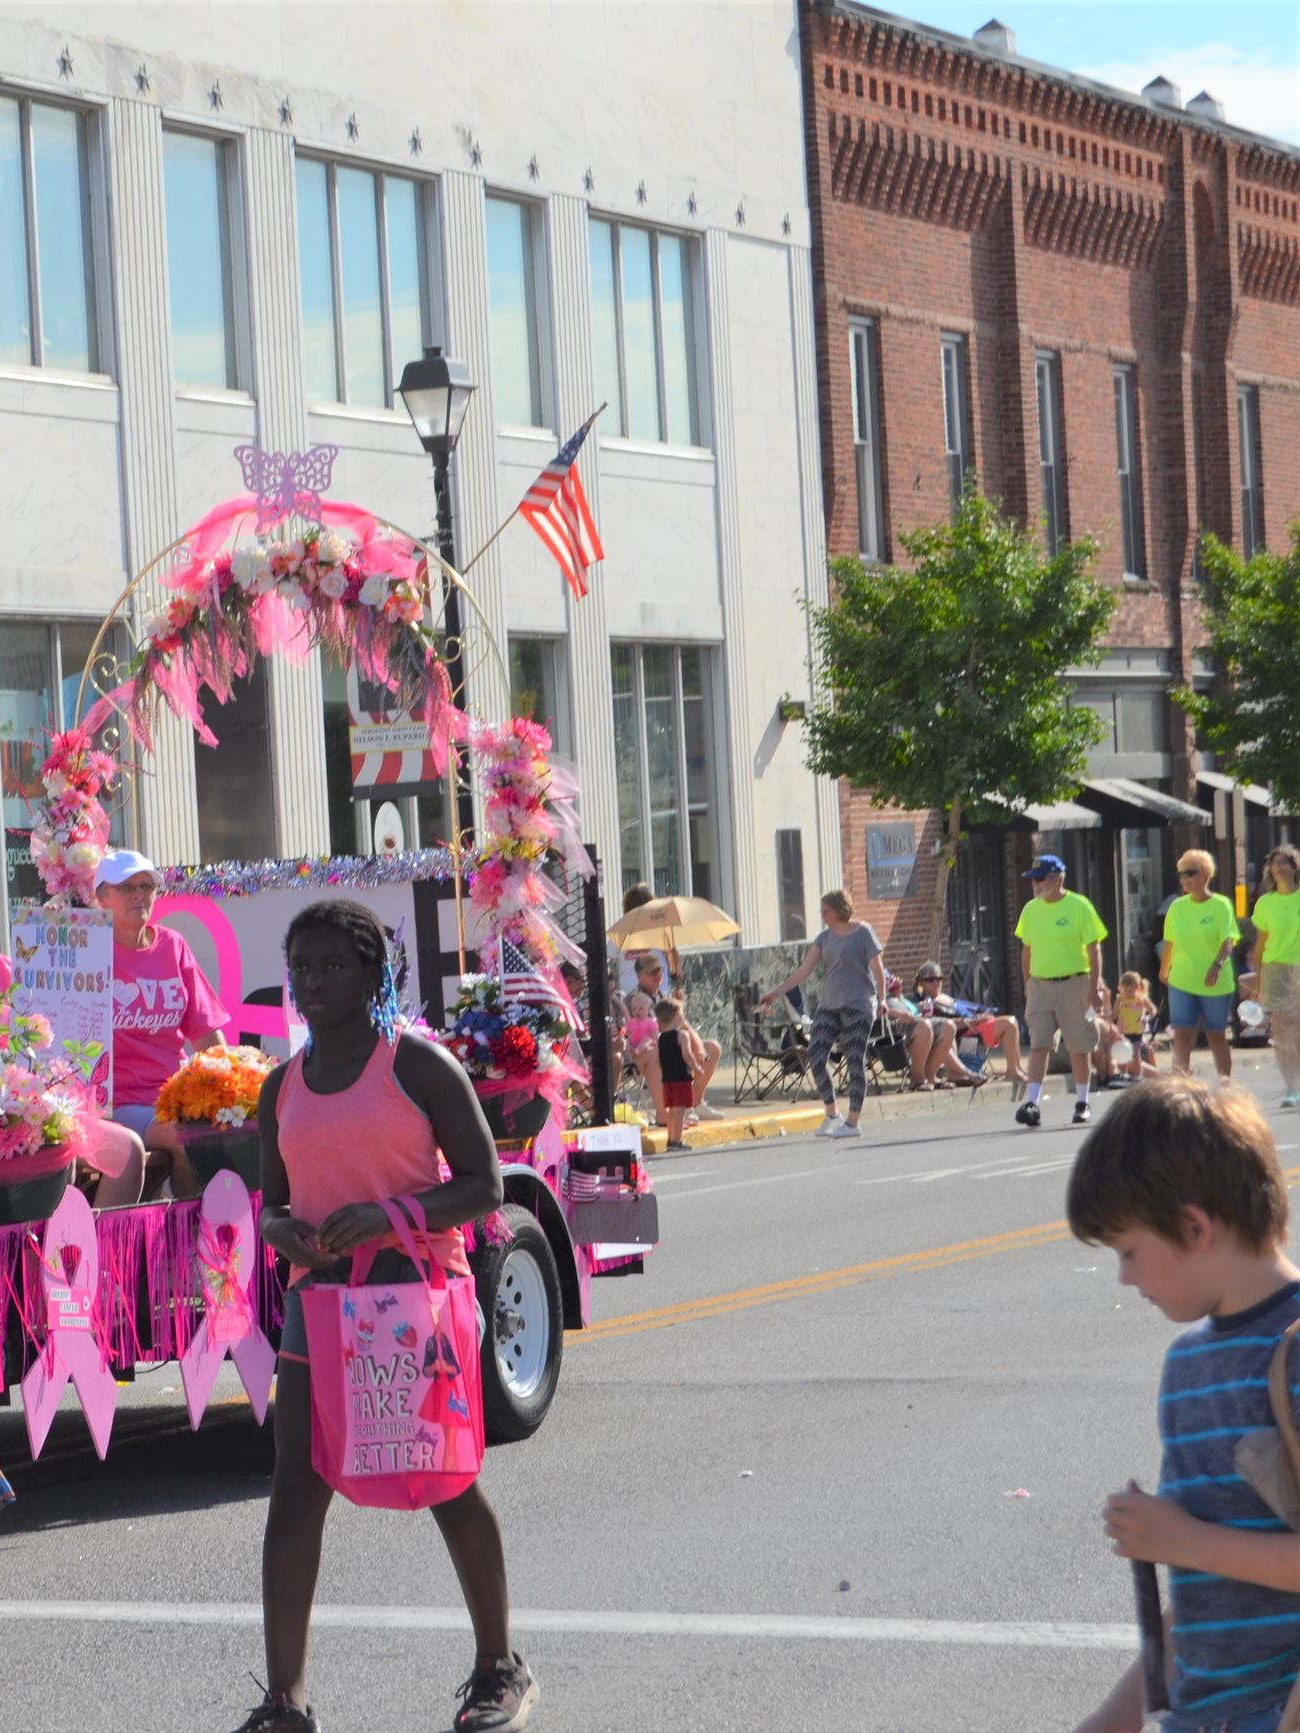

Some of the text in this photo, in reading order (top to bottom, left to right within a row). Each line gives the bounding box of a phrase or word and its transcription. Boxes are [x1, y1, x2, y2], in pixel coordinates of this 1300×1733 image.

[36, 925, 89, 948] HONOR
[48, 948, 77, 969] THE
[13, 966, 112, 993] SURVIVORS!
[113, 1007, 183, 1035] uckeyes
[353, 1440, 435, 1474] BETTER
